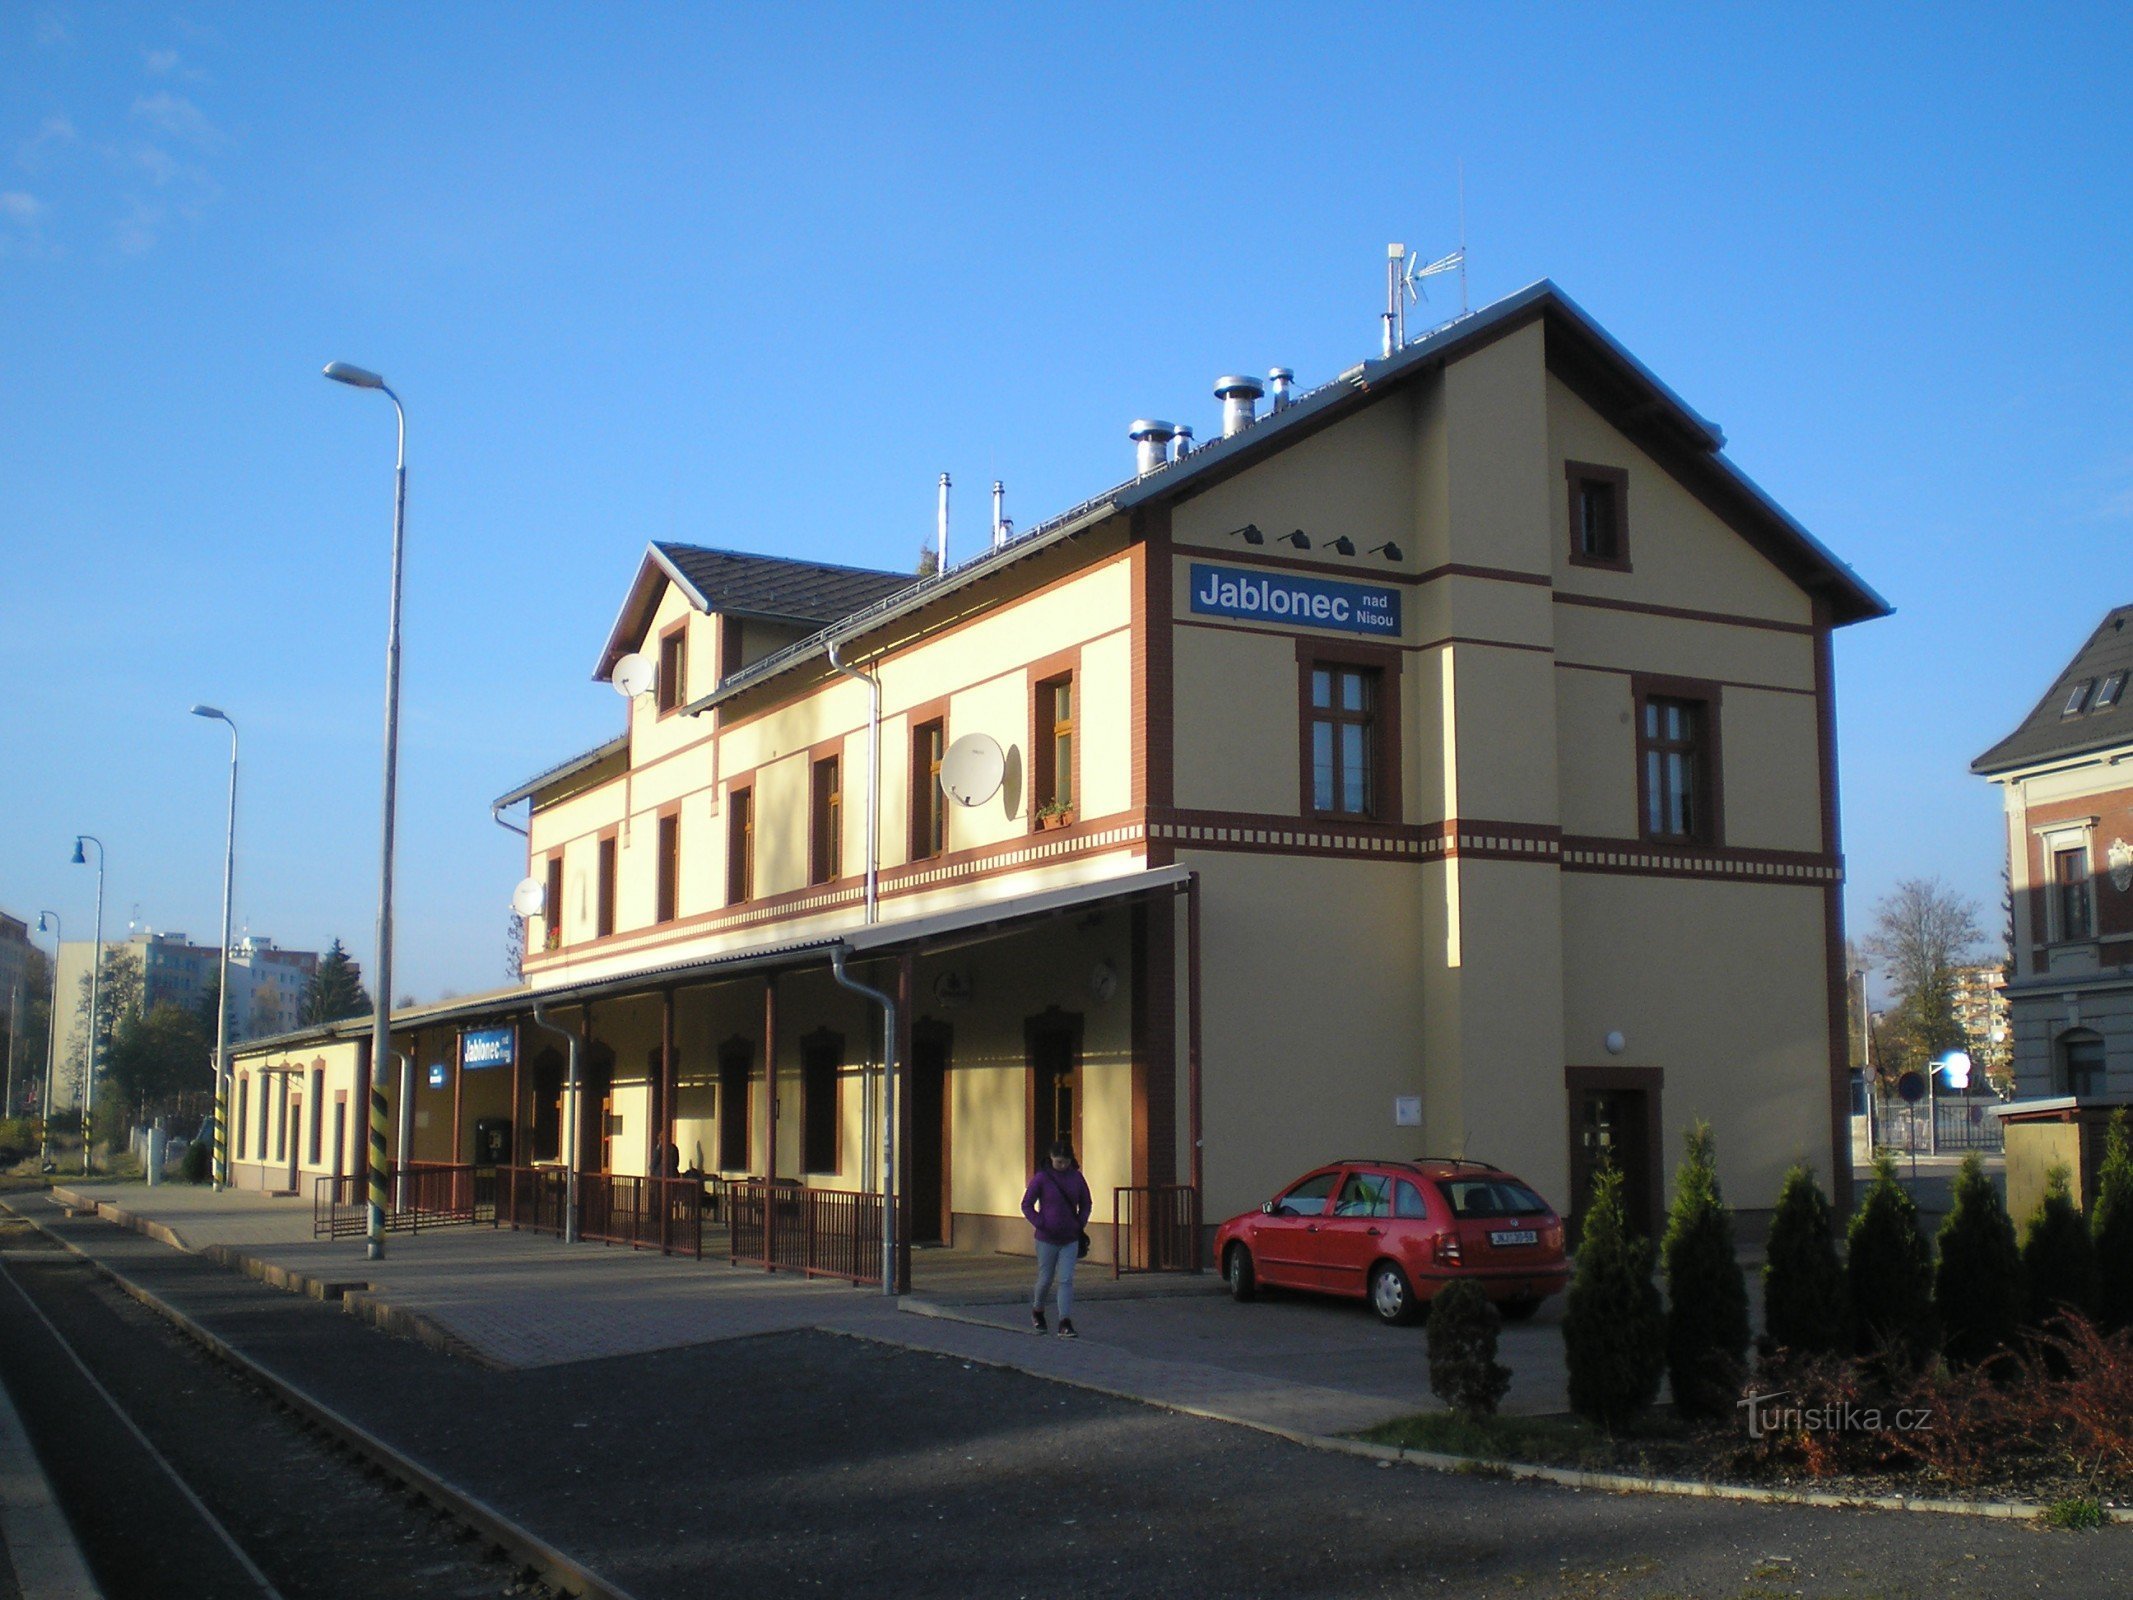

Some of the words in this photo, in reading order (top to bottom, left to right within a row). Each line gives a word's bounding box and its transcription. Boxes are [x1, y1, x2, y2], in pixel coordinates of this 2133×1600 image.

[1200, 573, 1350, 622] Jablonec
[1363, 594, 1388, 609] nad
[1356, 610, 1394, 627] Nisou
[464, 1038, 500, 1063] Jablonec
